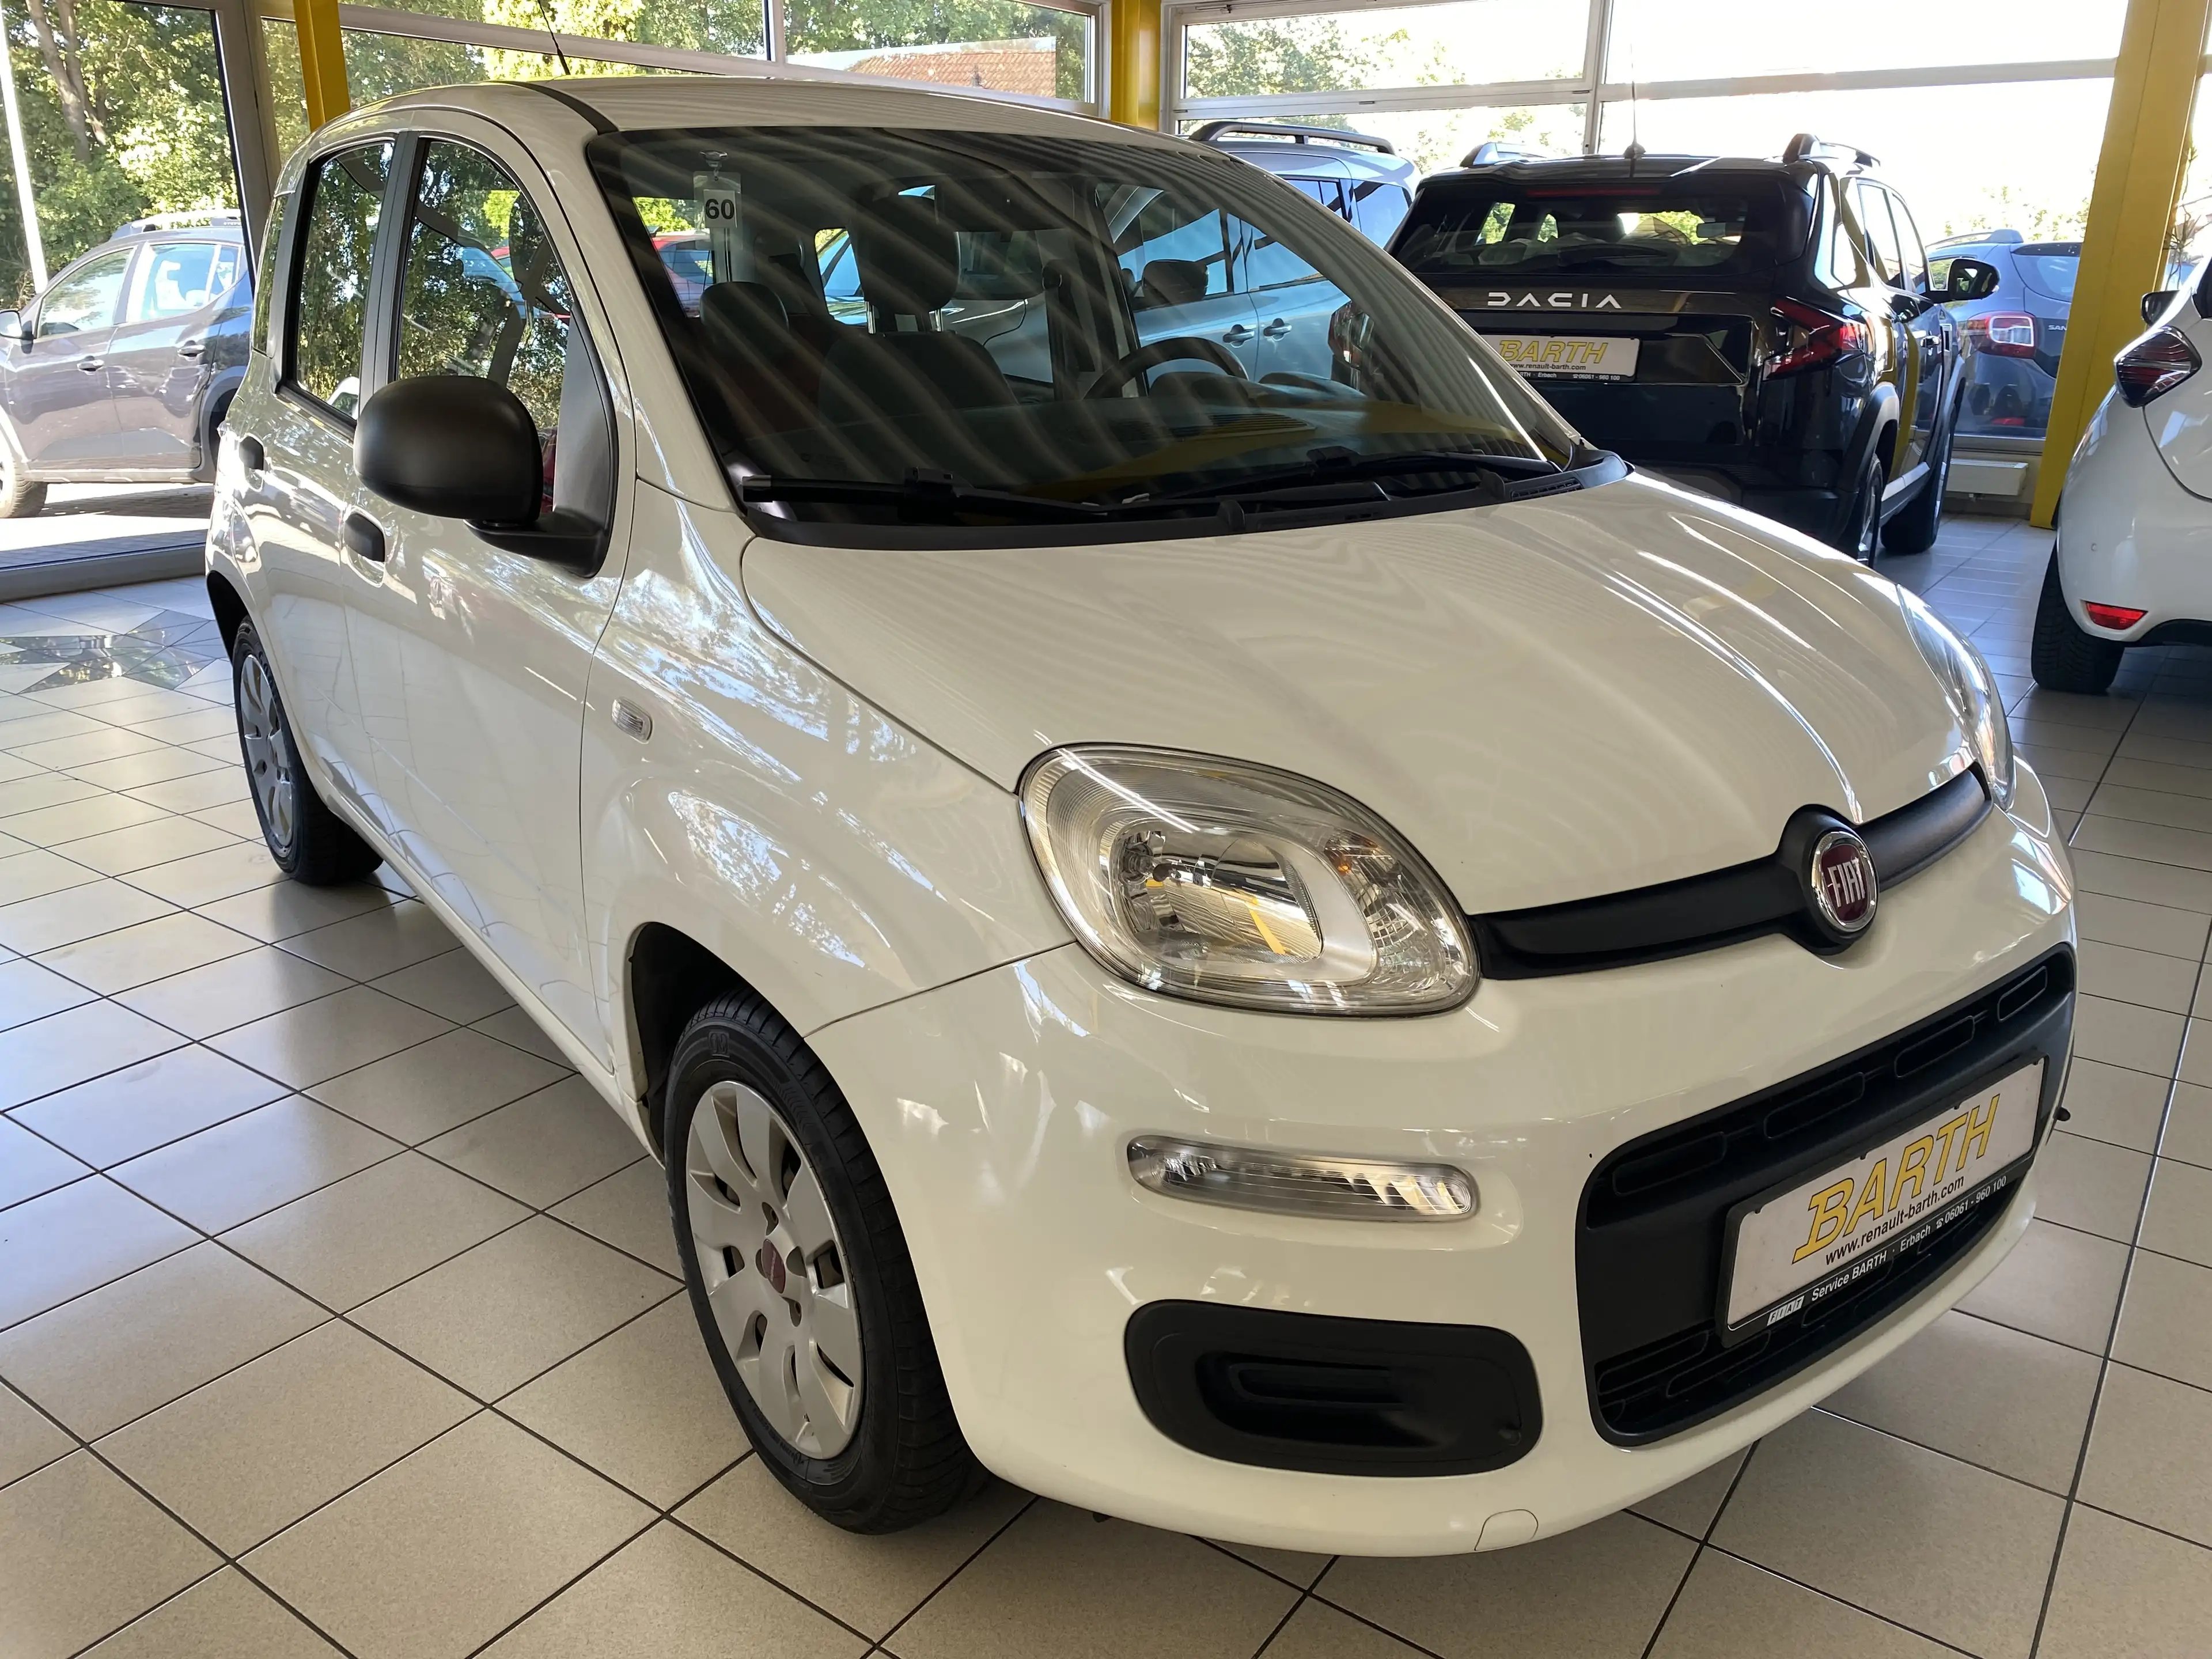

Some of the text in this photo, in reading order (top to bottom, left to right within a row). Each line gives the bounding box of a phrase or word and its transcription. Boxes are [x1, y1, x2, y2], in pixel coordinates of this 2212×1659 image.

[704, 198, 735, 219] 60
[1488, 291, 1622, 309] DACIA
[1499, 340, 1609, 364] BARTH
[1827, 857, 1866, 908] FIAT
[1791, 1093, 2000, 1265] BARTH
[1825, 1176, 1964, 1266] www.renault-barth.com
[1767, 1296, 1804, 1325] FIAT
[1811, 1273, 1850, 1302] Service
[1851, 1250, 1888, 1280] BARTH
[1900, 1224, 1931, 1252] Erbach
[1944, 1200, 1969, 1224] 06061
[1975, 1187, 1991, 1204] 960
[1992, 1175, 2007, 1191] 100
